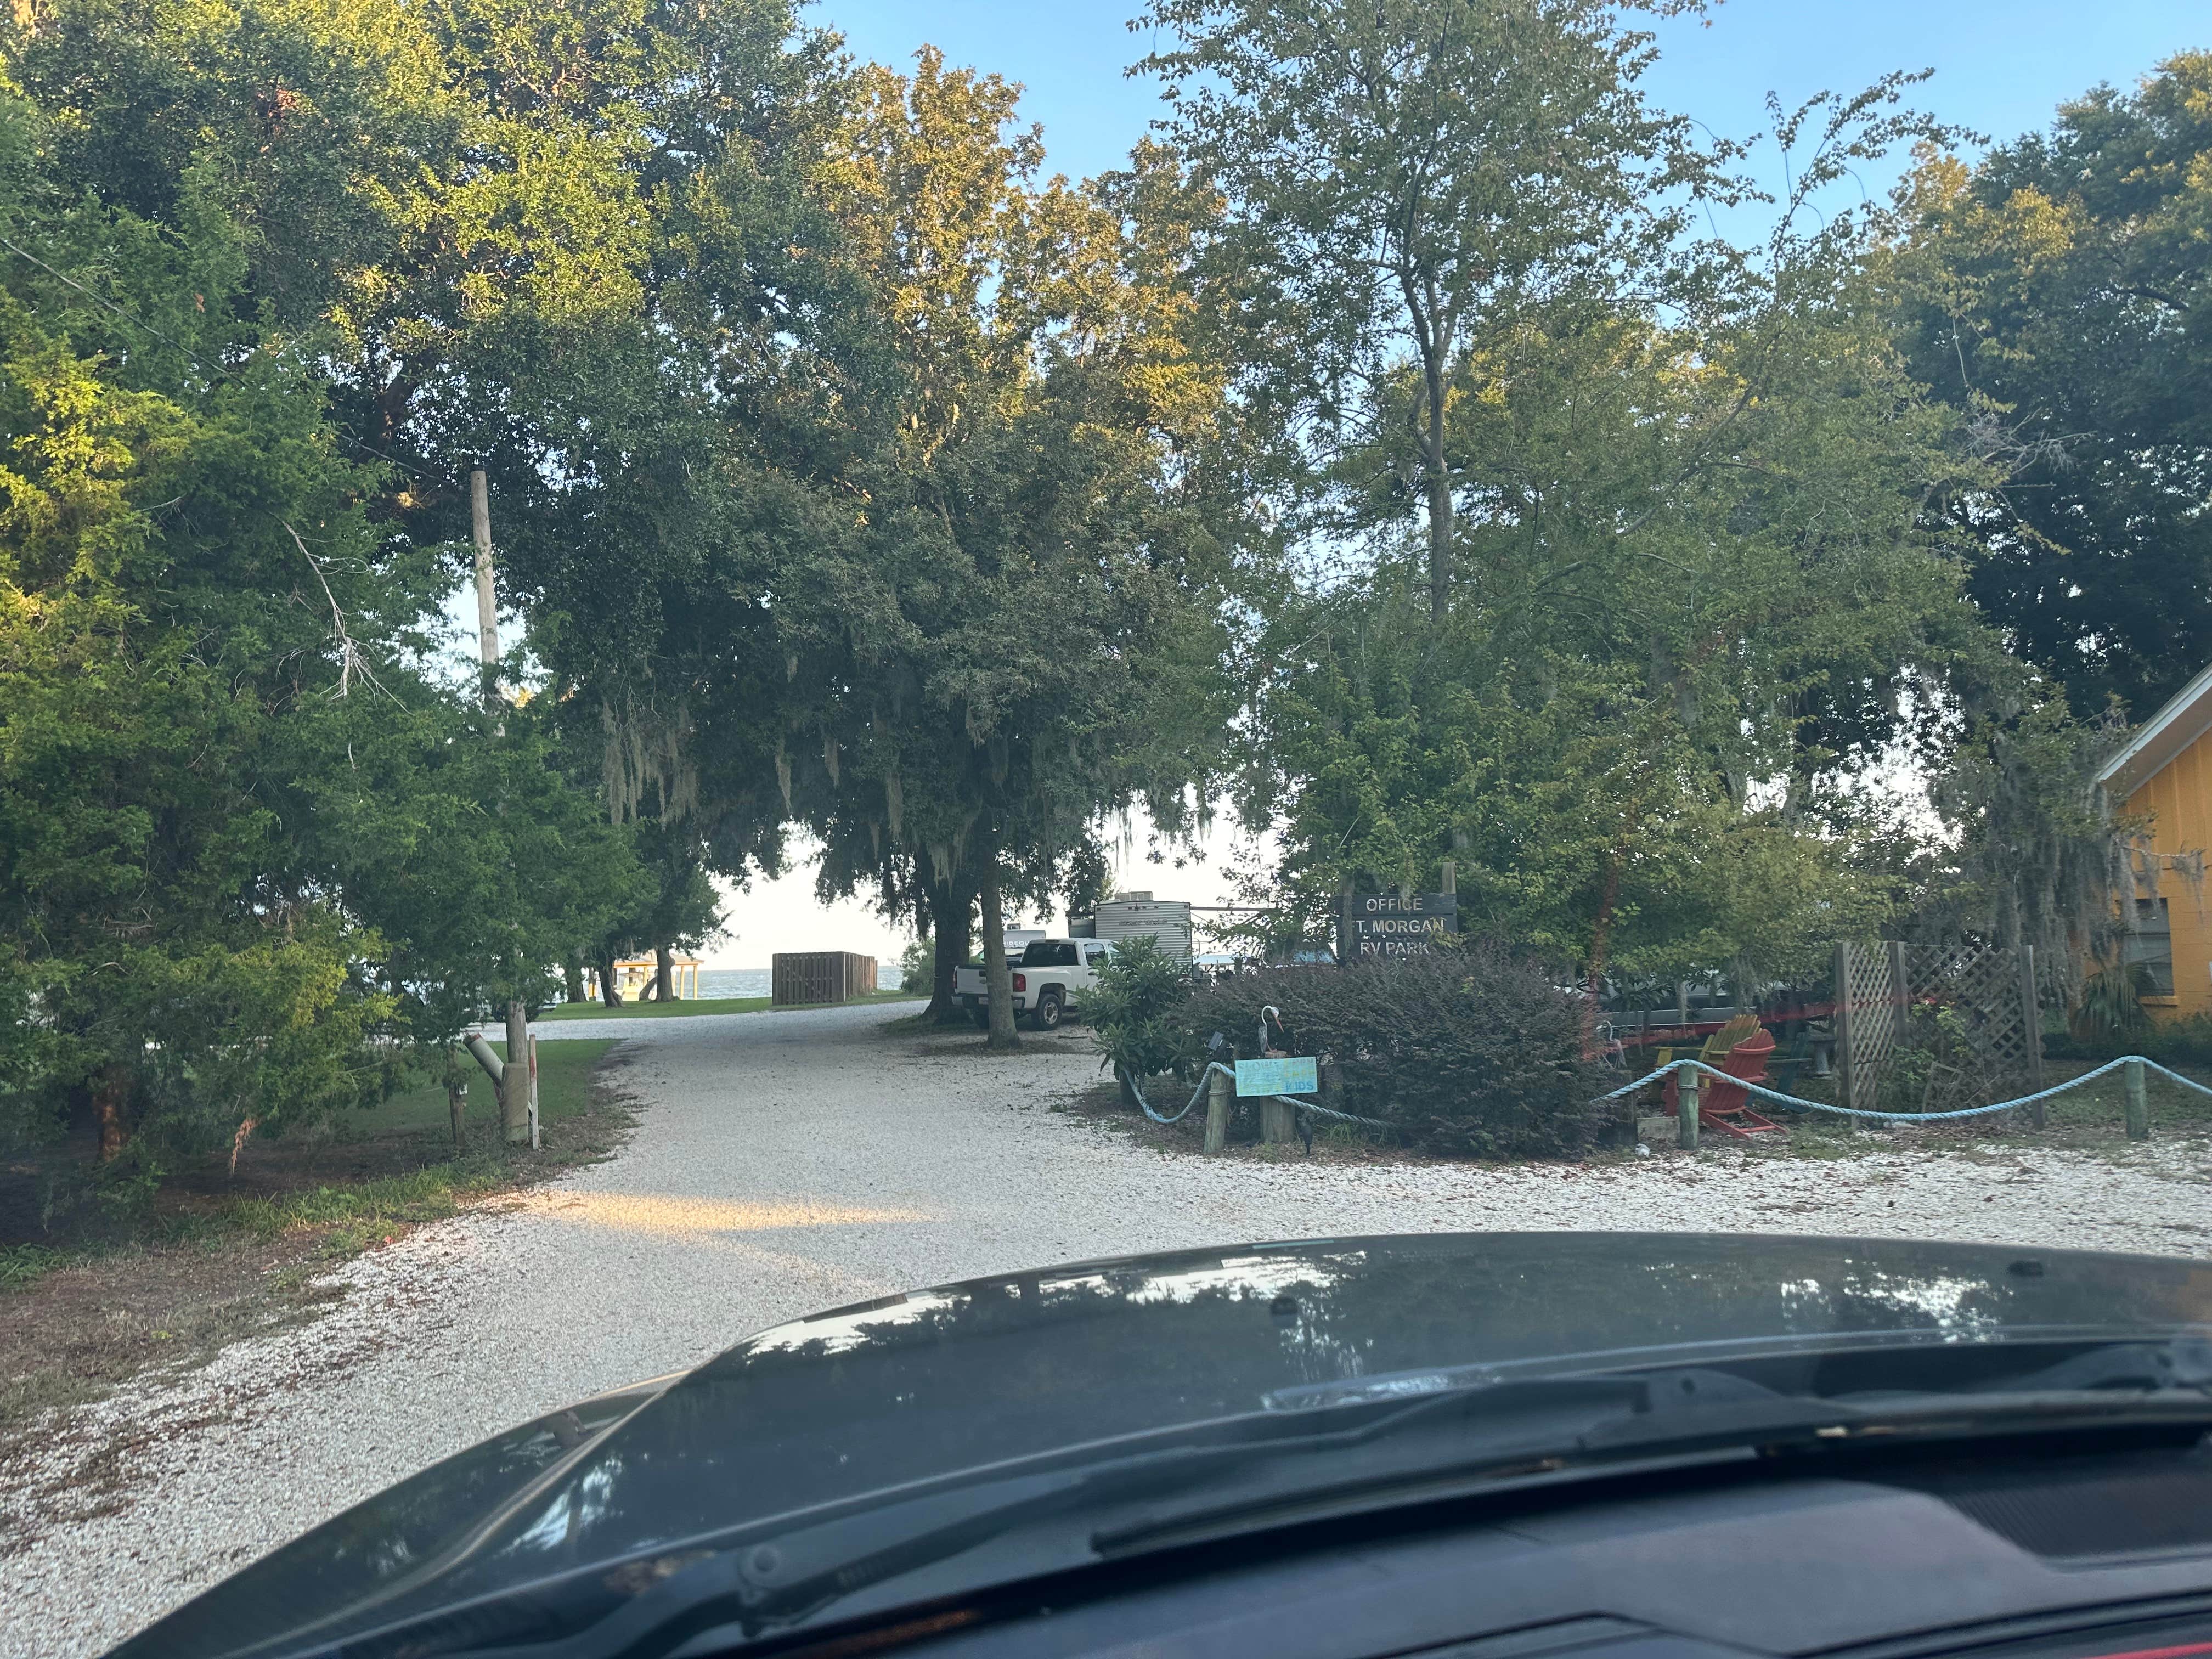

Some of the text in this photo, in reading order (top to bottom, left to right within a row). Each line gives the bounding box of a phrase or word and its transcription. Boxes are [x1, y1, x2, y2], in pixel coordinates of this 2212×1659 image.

[1366, 898, 1423, 912] OFFICE
[1352, 919, 1444, 933] T. MORGAN
[1360, 941, 1430, 955] RV PARK
[1285, 1081, 1314, 1092] KIDS
